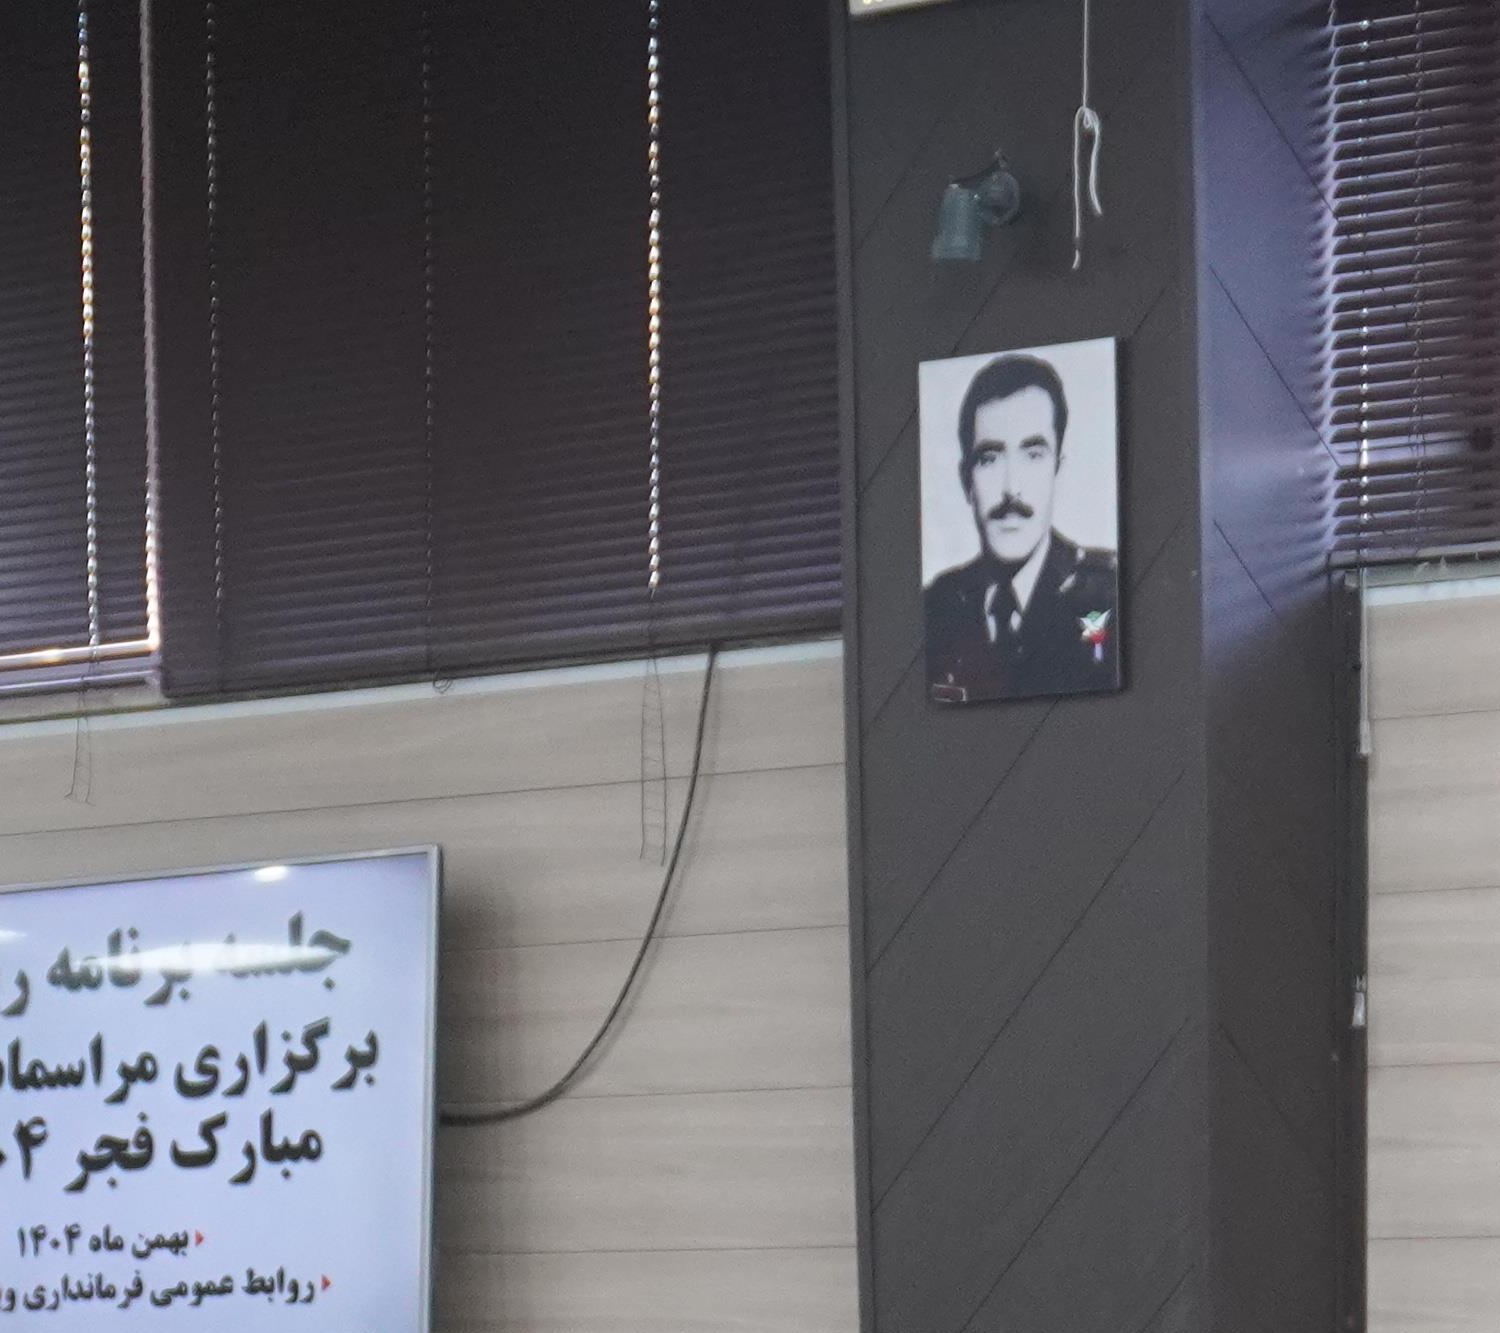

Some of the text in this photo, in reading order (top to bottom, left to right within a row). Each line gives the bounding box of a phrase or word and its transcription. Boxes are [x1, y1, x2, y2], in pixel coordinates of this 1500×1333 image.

[173, 1016, 380, 1100] برگزاری
[63, 1111, 156, 1194] فجر
[169, 1107, 325, 1186] مبارک
[17, 1223, 190, 1261] بهمن ماه ۱۴۰۴
[22, 1270, 145, 1312] فرمانداری
[149, 1274, 235, 1309] عمومی
[241, 1266, 316, 1305] روابط
